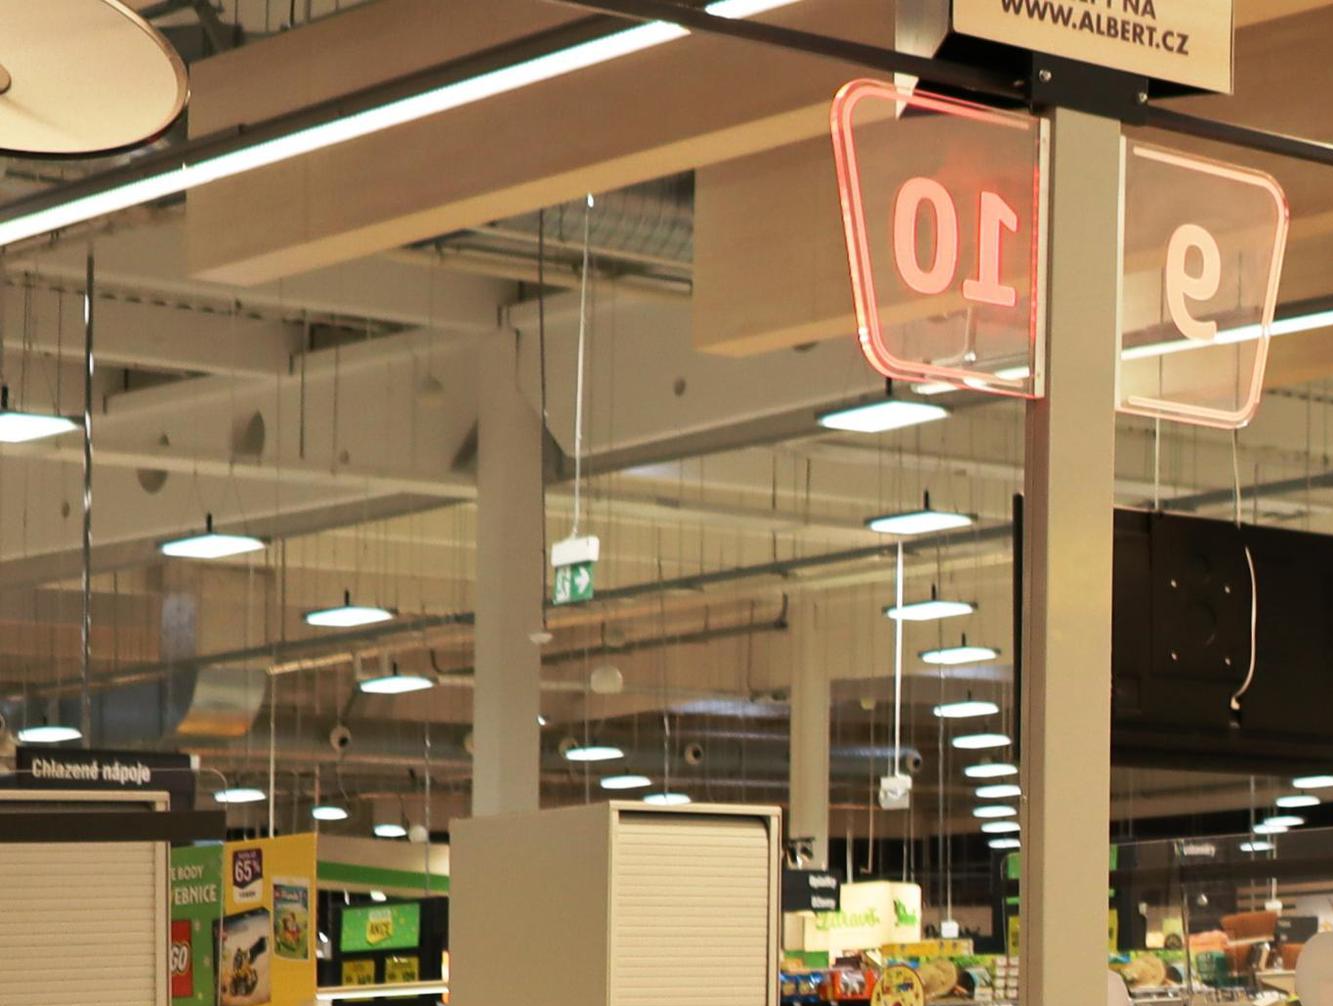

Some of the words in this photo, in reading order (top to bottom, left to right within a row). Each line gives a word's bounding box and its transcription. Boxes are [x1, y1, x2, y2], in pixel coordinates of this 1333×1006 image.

[1002, 0, 1190, 55] WWW.ALBERT.CZ
[32, 759, 99, 782] Chlazené
[102, 759, 151, 785] nápoje
[178, 865, 204, 880] BODY
[174, 884, 217, 905] EBNICE
[171, 944, 188, 974] GO
